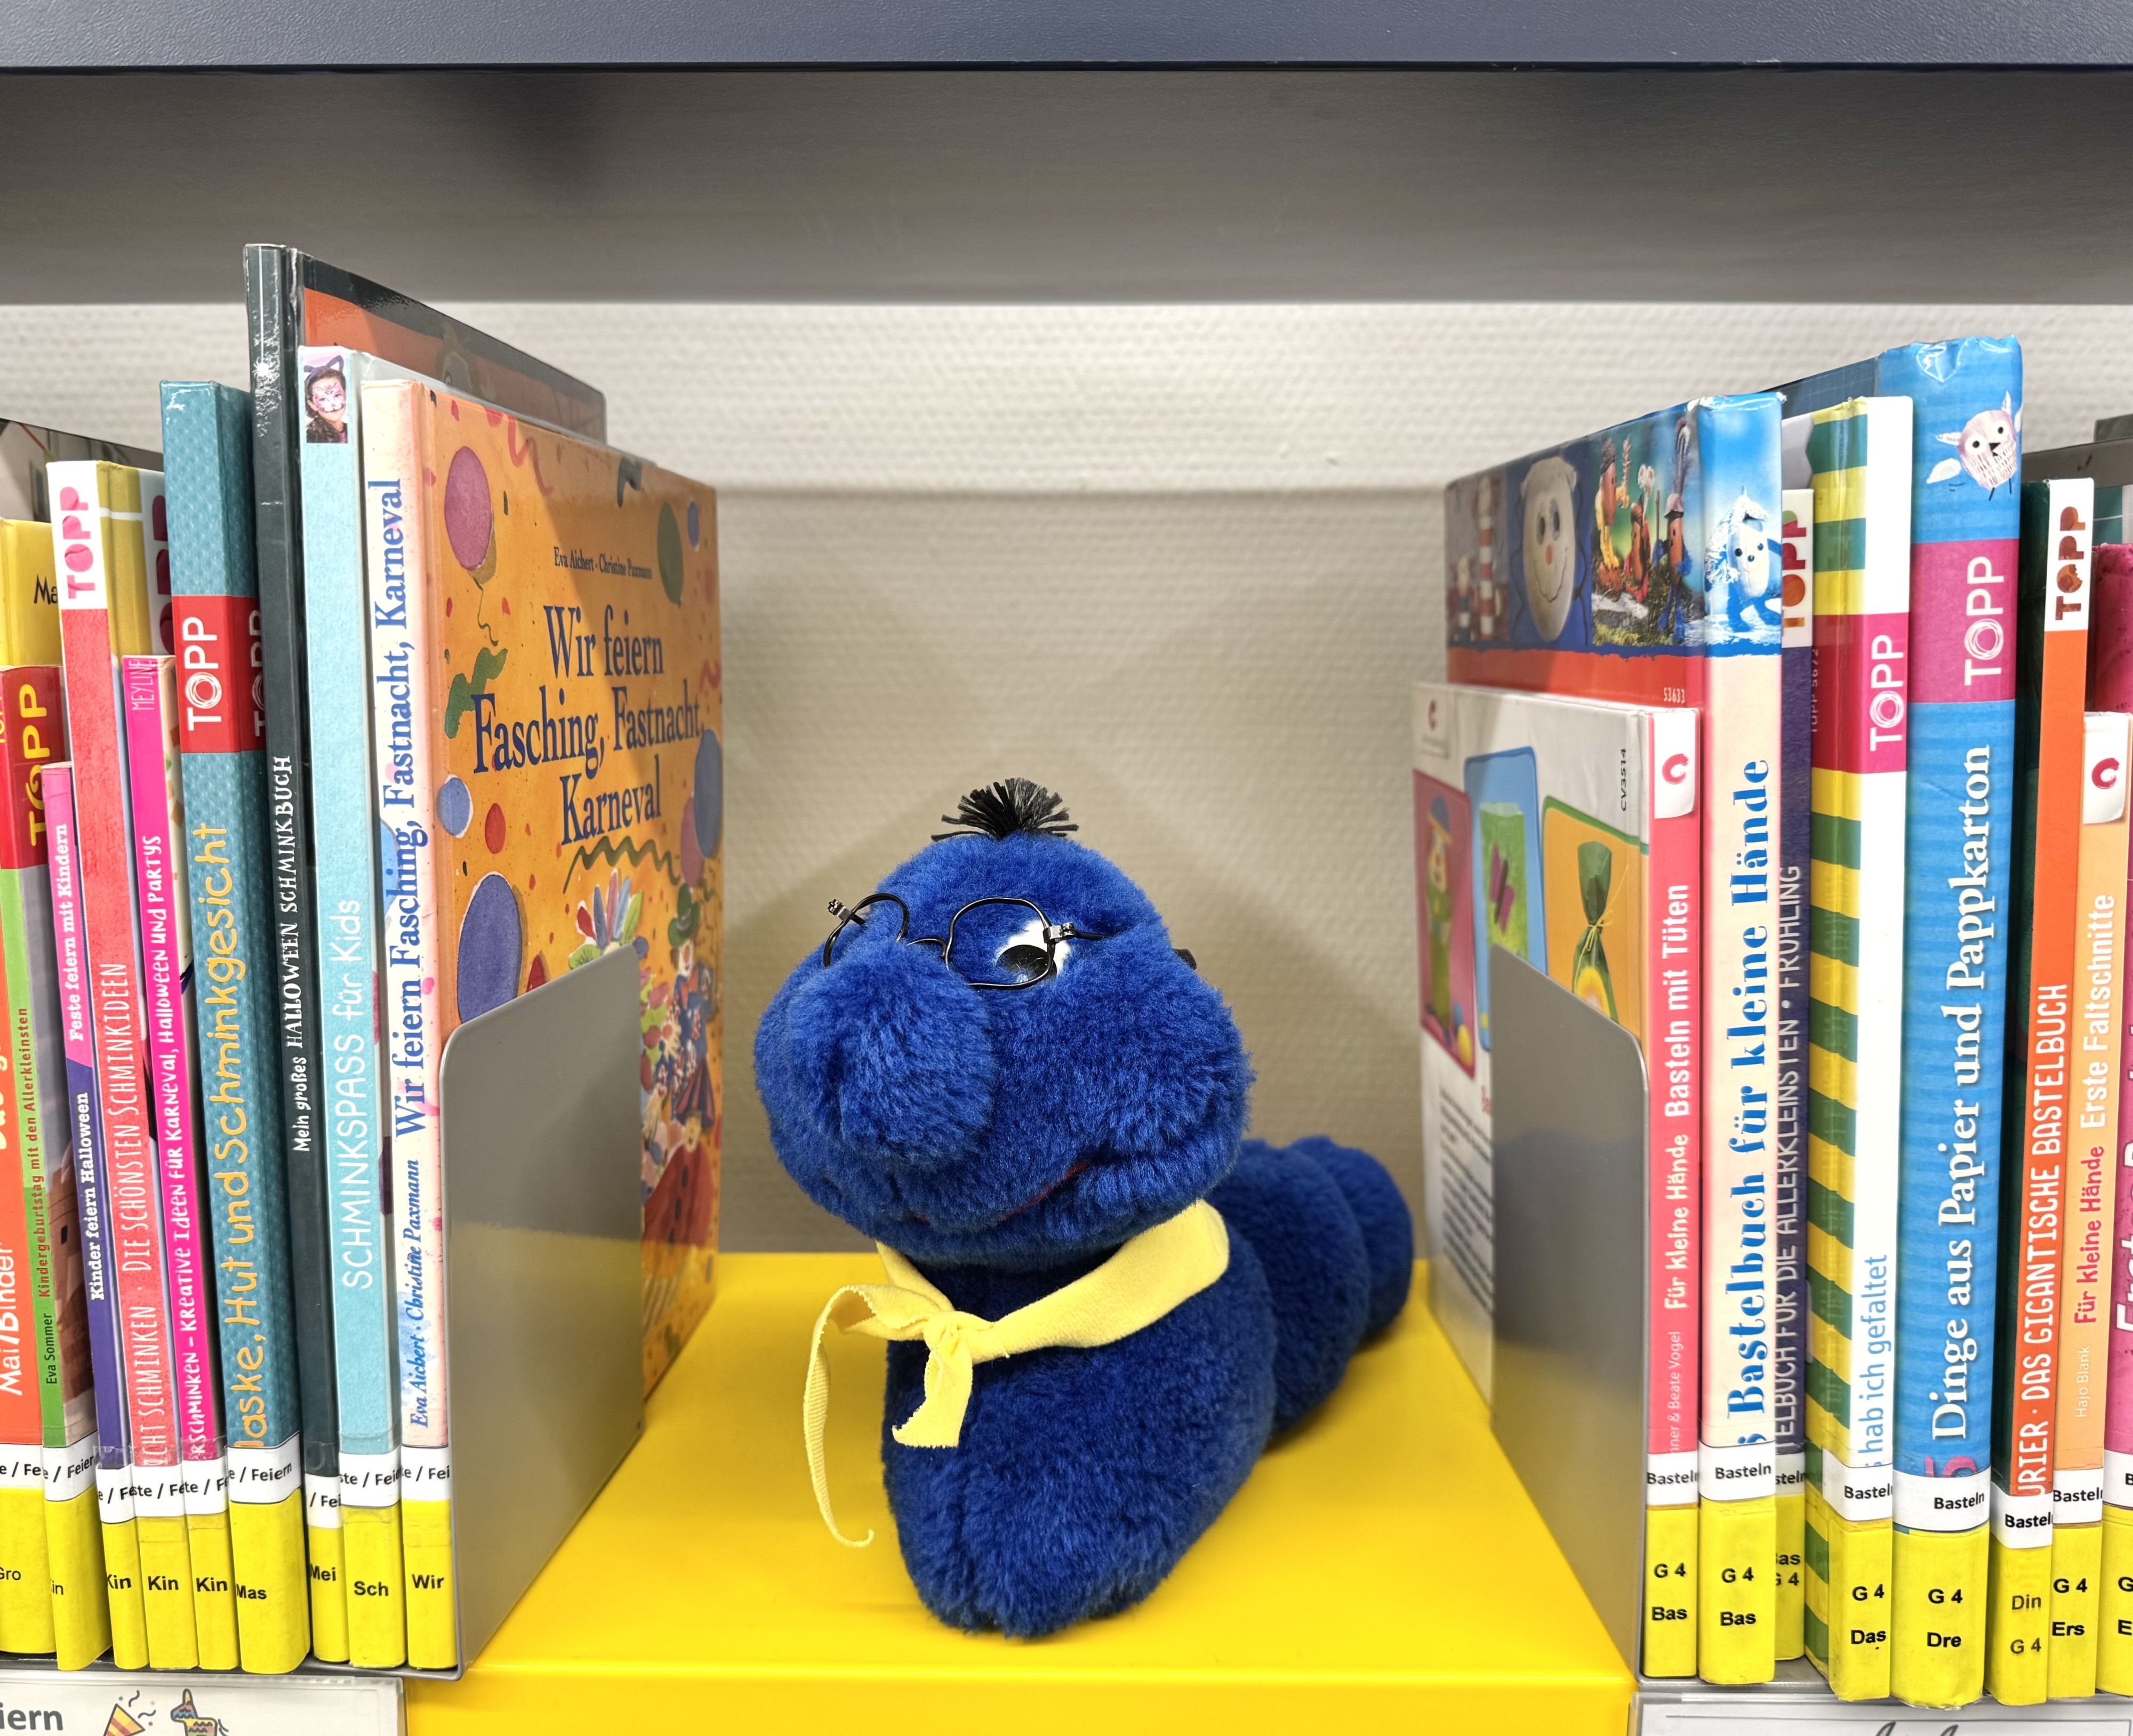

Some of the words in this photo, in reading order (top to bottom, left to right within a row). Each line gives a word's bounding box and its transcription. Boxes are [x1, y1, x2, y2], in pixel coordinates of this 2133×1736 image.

[60, 486, 95, 599] TOPP
[367, 478, 407, 630] Karneval
[554, 547, 568, 567] Eva
[570, 549, 594, 572] Aichert
[599, 554, 627, 576] Christine
[2055, 506, 2086, 620] TOPP
[543, 605, 597, 678] Wir
[603, 603, 664, 677] feiern
[1964, 556, 2005, 686] TOPP
[128, 659, 158, 711] MEYLINE
[182, 616, 222, 731] TOPP
[1663, 686, 1686, 703] 53633
[1870, 635, 1904, 751] TOPP
[376, 641, 415, 809] Fastnacht,
[471, 685, 605, 780] Fasching,
[612, 678, 704, 751] Fastnacht,
[19, 684, 50, 847] TOPP
[560, 755, 662, 846] Karneval
[55, 823, 73, 898] Kindern
[274, 755, 299, 913] SCHMINKBUCH
[1730, 759, 1769, 906] Hände
[386, 820, 429, 968] Fasching,
[1945, 745, 1995, 991] Pappkarton
[60, 901, 74, 933] mit
[330, 899, 362, 961] Kids
[1662, 884, 1689, 959] Tüten
[62, 937, 80, 993] feiern
[193, 823, 248, 1161] Schminkgesicht
[279, 923, 303, 1049] HALLOWEEN
[1663, 969, 1688, 1010] mit
[2083, 894, 2115, 1051] Faltschnitte
[67, 995, 84, 1043] Feste
[333, 973, 365, 1024] für
[391, 979, 424, 1070] feiern
[1726, 925, 1768, 1069] kleine
[18, 1008, 35, 1111] Allerkleinsten
[100, 963, 139, 1116] SCHMINKIDEEN
[1664, 1019, 1690, 1117] Basteln
[1940, 1002, 1983, 1087] und
[291, 1057, 312, 1113] großes
[2031, 984, 2068, 1156] BASTELBUCH
[2080, 1060, 2108, 1129] Erste
[22, 1117, 37, 1142] den
[76, 1091, 94, 1183] Halloween
[293, 1114, 310, 1152] Mein
[392, 1079, 427, 1140] Wir
[1728, 1085, 1768, 1155] für
[24, 1147, 40, 1171] mit
[114, 1125, 149, 1231] SCHÖNSTEN
[334, 1035, 374, 1290] SCHMINKSPASS
[1665, 1134, 1689, 1199] Hände
[1938, 1098, 1985, 1228] Papier
[2080, 1145, 2104, 1213] Hände
[81, 1186, 98, 1237] feiern
[214, 1171, 255, 1244] und
[402, 1159, 421, 1243] Paxmann
[30, 1175, 51, 1298] Kindergeburtstag
[123, 1239, 151, 1272] DIE
[1665, 1207, 1689, 1270] kleine
[1776, 1245, 1797, 1280] DIE
[2024, 1163, 2060, 1345] GIGANTISCHE
[2076, 1220, 2102, 1284] kleine
[88, 1242, 105, 1301] Kinder
[221, 1257, 260, 1326] Hut
[404, 1246, 424, 1321] Christine
[1664, 1276, 1688, 1309] Für
[1726, 1171, 1768, 1419] Bastelbuch
[1946, 1238, 1972, 1307] aus
[1861, 1254, 1891, 1355] gefaltet
[2074, 1291, 2097, 1324] Für
[43, 1313, 55, 1361] Sommer
[129, 1306, 166, 1416] SCHMINKEN
[408, 1334, 427, 1394] Aichert
[1667, 1331, 1682, 1369] Vogel
[2076, 1346, 2091, 1383] Blank
[46, 1364, 57, 1385] Eva
[230, 1334, 267, 1447] aske,
[1667, 1372, 1680, 1409] Beate
[1858, 1363, 1885, 1401] ich
[1929, 1318, 1978, 1442] Dinge
[2021, 1353, 2052, 1401] DAS
[2075, 1387, 2092, 1418] Hajo
[410, 1396, 429, 1428] Eva
[1668, 1412, 1680, 1422] &
[1858, 1406, 1884, 1454] hab
[252, 1462, 292, 1481] Feiern
[1715, 1463, 1771, 1479] Basteln
[1934, 1492, 1984, 1509] Basteln
[147, 1575, 179, 1591] Kin
[196, 1577, 228, 1592] Kin
[310, 1563, 336, 1581] Mei
[412, 1574, 445, 1589] Wir
[1654, 1563, 1668, 1578] G
[1674, 1563, 1686, 1577] 4
[1721, 1569, 1736, 1583] G
[1742, 1567, 1754, 1581] 4
[1776, 1553, 1801, 1565] as
[1788, 1572, 1799, 1586] 4
[2054, 1579, 2070, 1593] G
[2075, 1578, 2088, 1593] 4
[236, 1583, 267, 1600] Mas
[354, 1581, 389, 1597] Sch
[1651, 1606, 1688, 1621] Bas
[1720, 1611, 1757, 1626] Bas
[1852, 1586, 1868, 1601] G
[1874, 1584, 1885, 1598] 4
[1928, 1590, 1944, 1604] G
[1951, 1589, 1963, 1603] 4
[2012, 1595, 2042, 1610] Din
[1850, 1629, 1887, 1644] Das
[1927, 1632, 1962, 1647] Dre
[2010, 1639, 2025, 1654] G
[2031, 1637, 2042, 1652] 4
[2052, 1621, 2085, 1636] Ers
